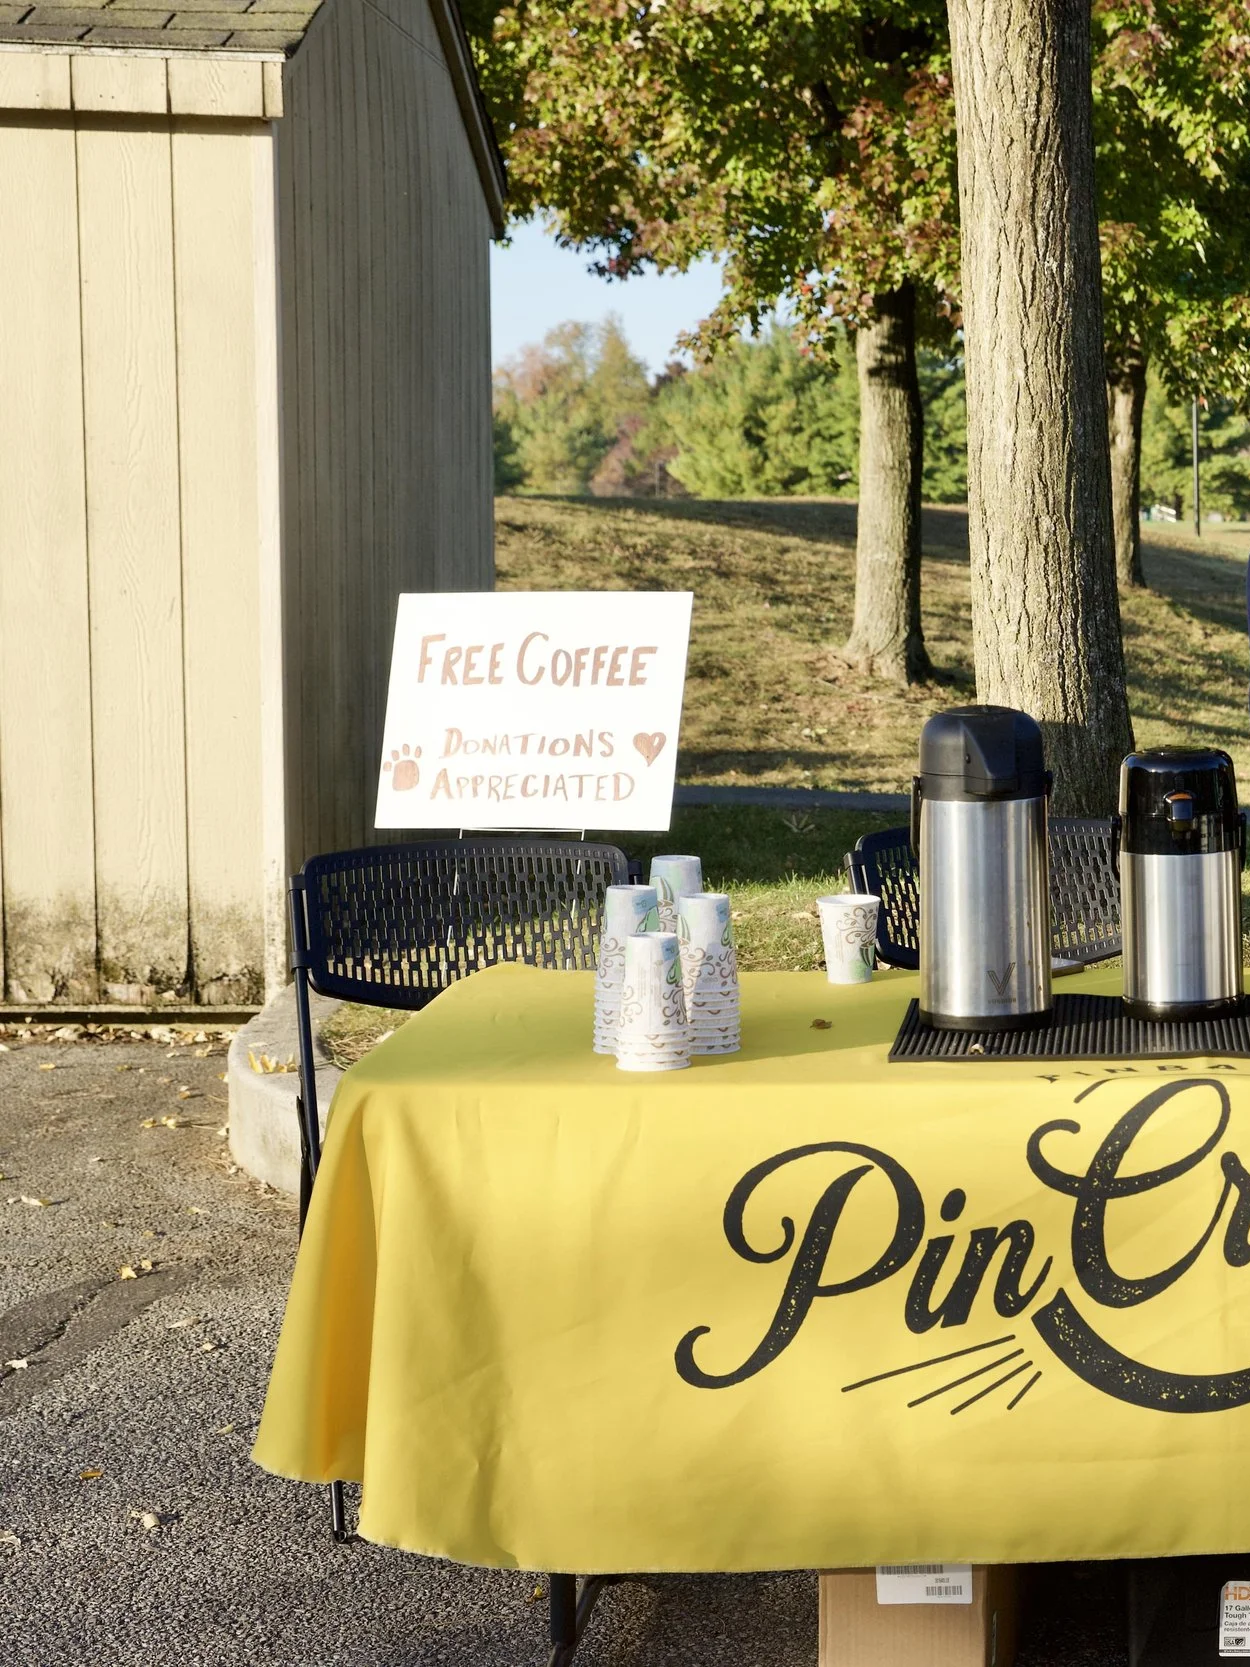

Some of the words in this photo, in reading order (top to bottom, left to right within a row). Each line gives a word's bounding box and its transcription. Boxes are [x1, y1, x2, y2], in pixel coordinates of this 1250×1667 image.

[417, 633, 505, 686] FREE
[516, 632, 658, 687] COFFEE
[439, 727, 615, 759] DONATIONS
[430, 768, 635, 802] APPRECIATED
[674, 1141, 1053, 1389] Pin
[1225, 1612, 1247, 1620] Tough
